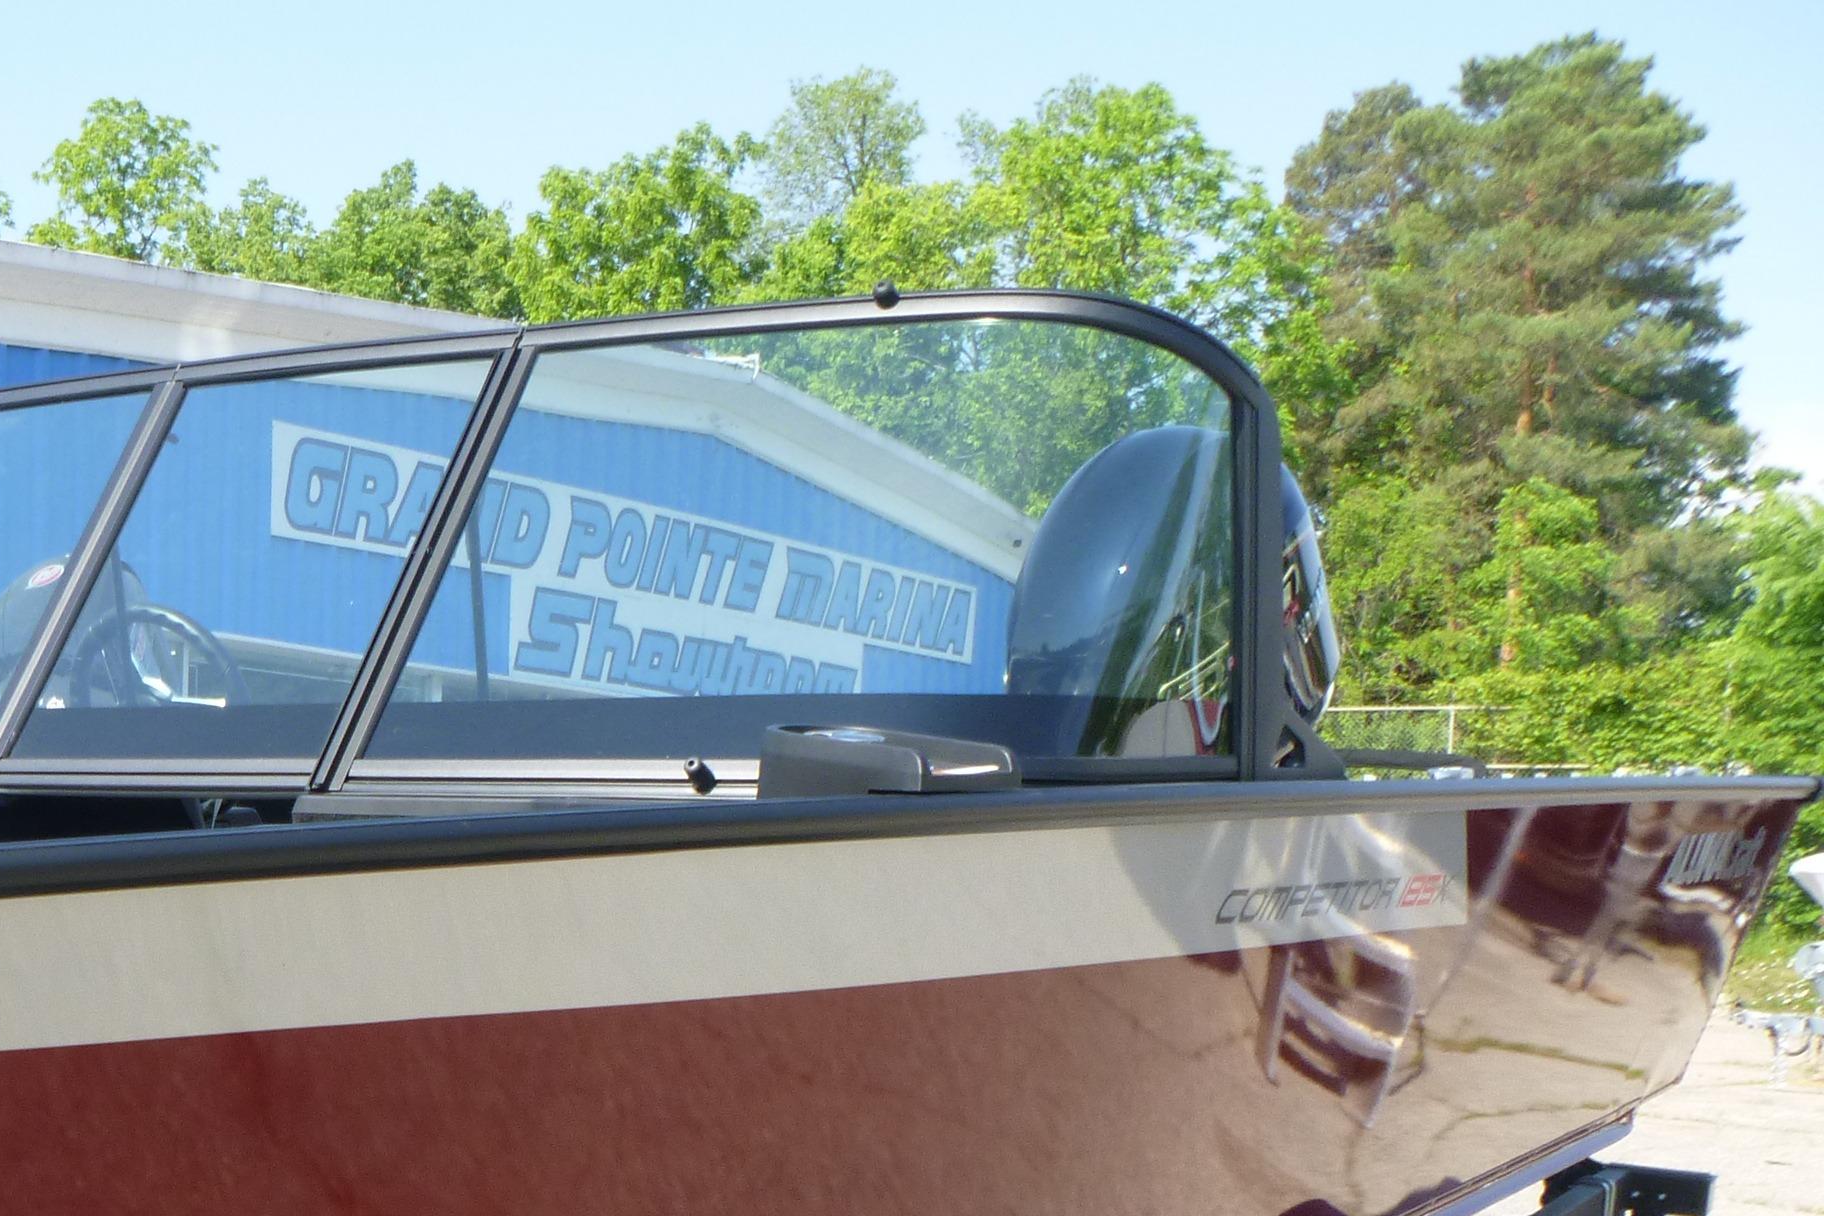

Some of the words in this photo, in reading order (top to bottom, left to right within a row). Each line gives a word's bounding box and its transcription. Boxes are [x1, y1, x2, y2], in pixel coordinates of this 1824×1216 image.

[557, 495, 775, 613] POINTE
[775, 546, 972, 656] MARINA
[1215, 882, 1401, 925] COMPETITOR
